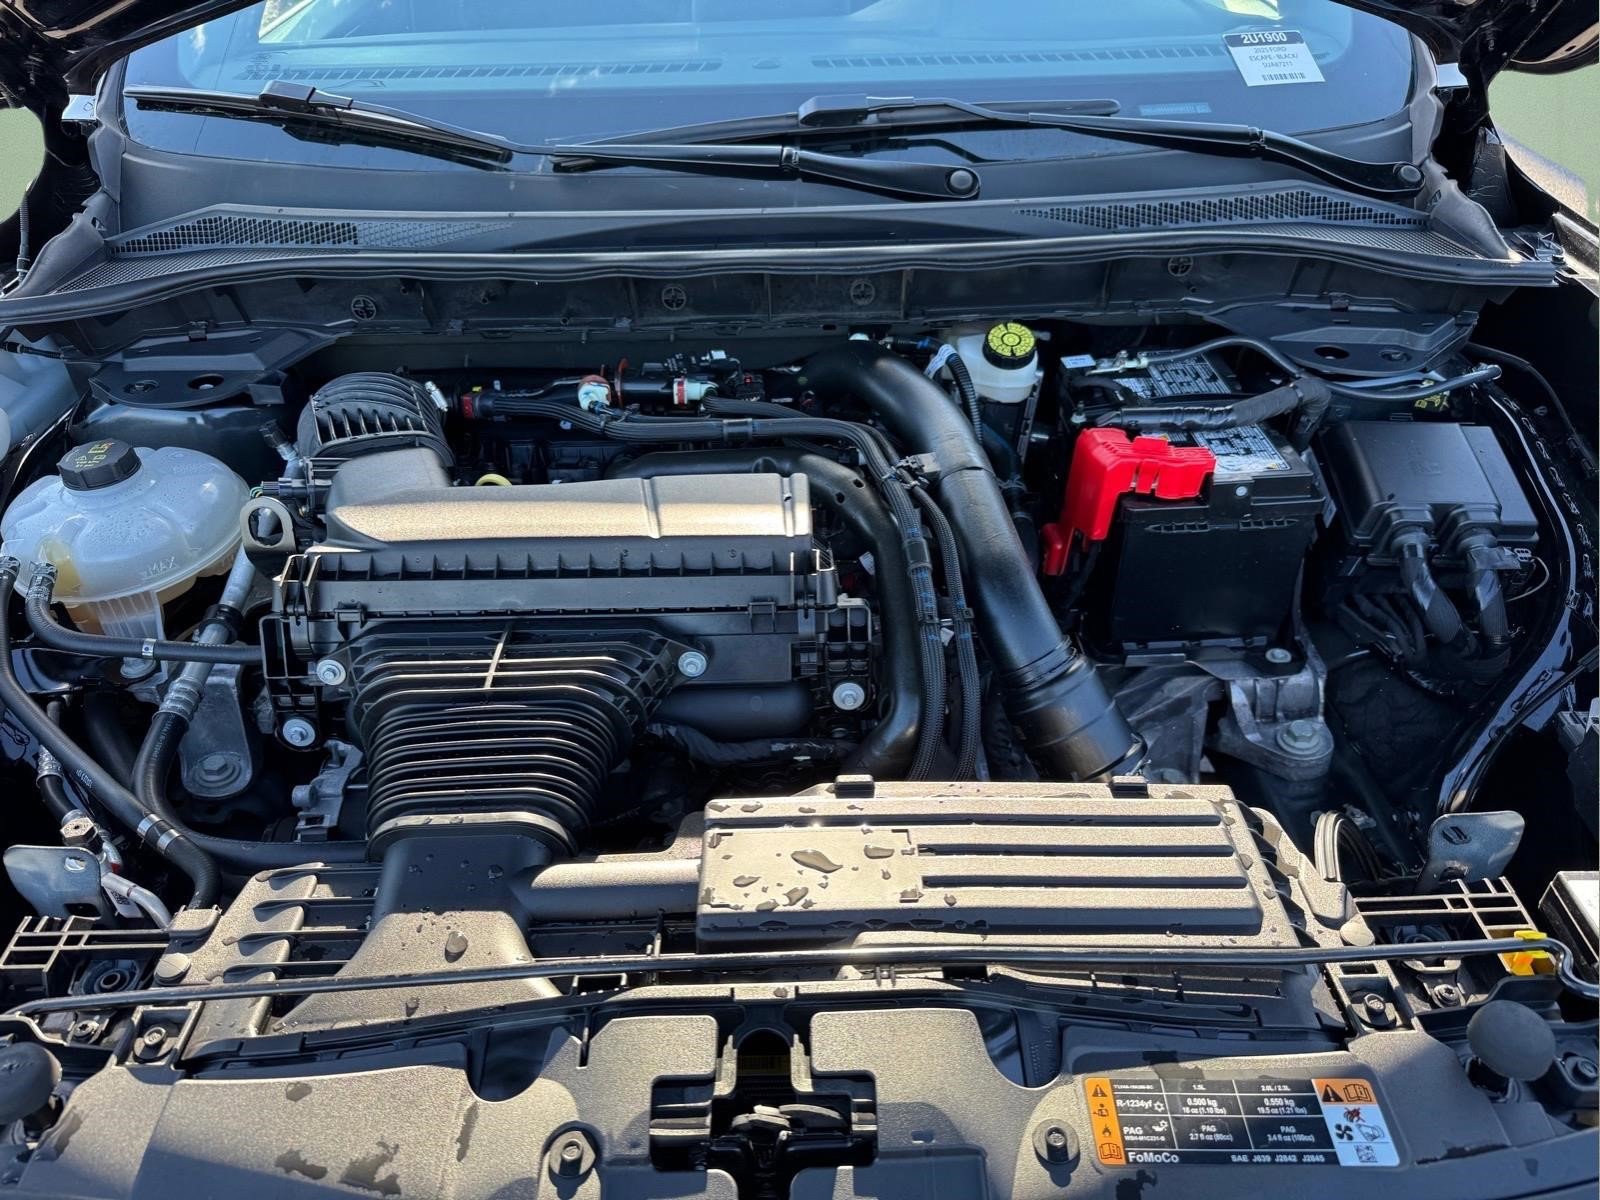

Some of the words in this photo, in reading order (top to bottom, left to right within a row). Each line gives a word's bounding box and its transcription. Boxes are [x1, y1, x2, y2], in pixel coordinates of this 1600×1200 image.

[1241, 32, 1287, 44] 2U1900
[1116, 1099, 1152, 1109] R-1234yf
[1207, 1098, 1218, 1107] kg
[1284, 1098, 1295, 1107] kg
[1123, 1126, 1143, 1135] PAG
[1128, 1152, 1180, 1163] FoMoCo
